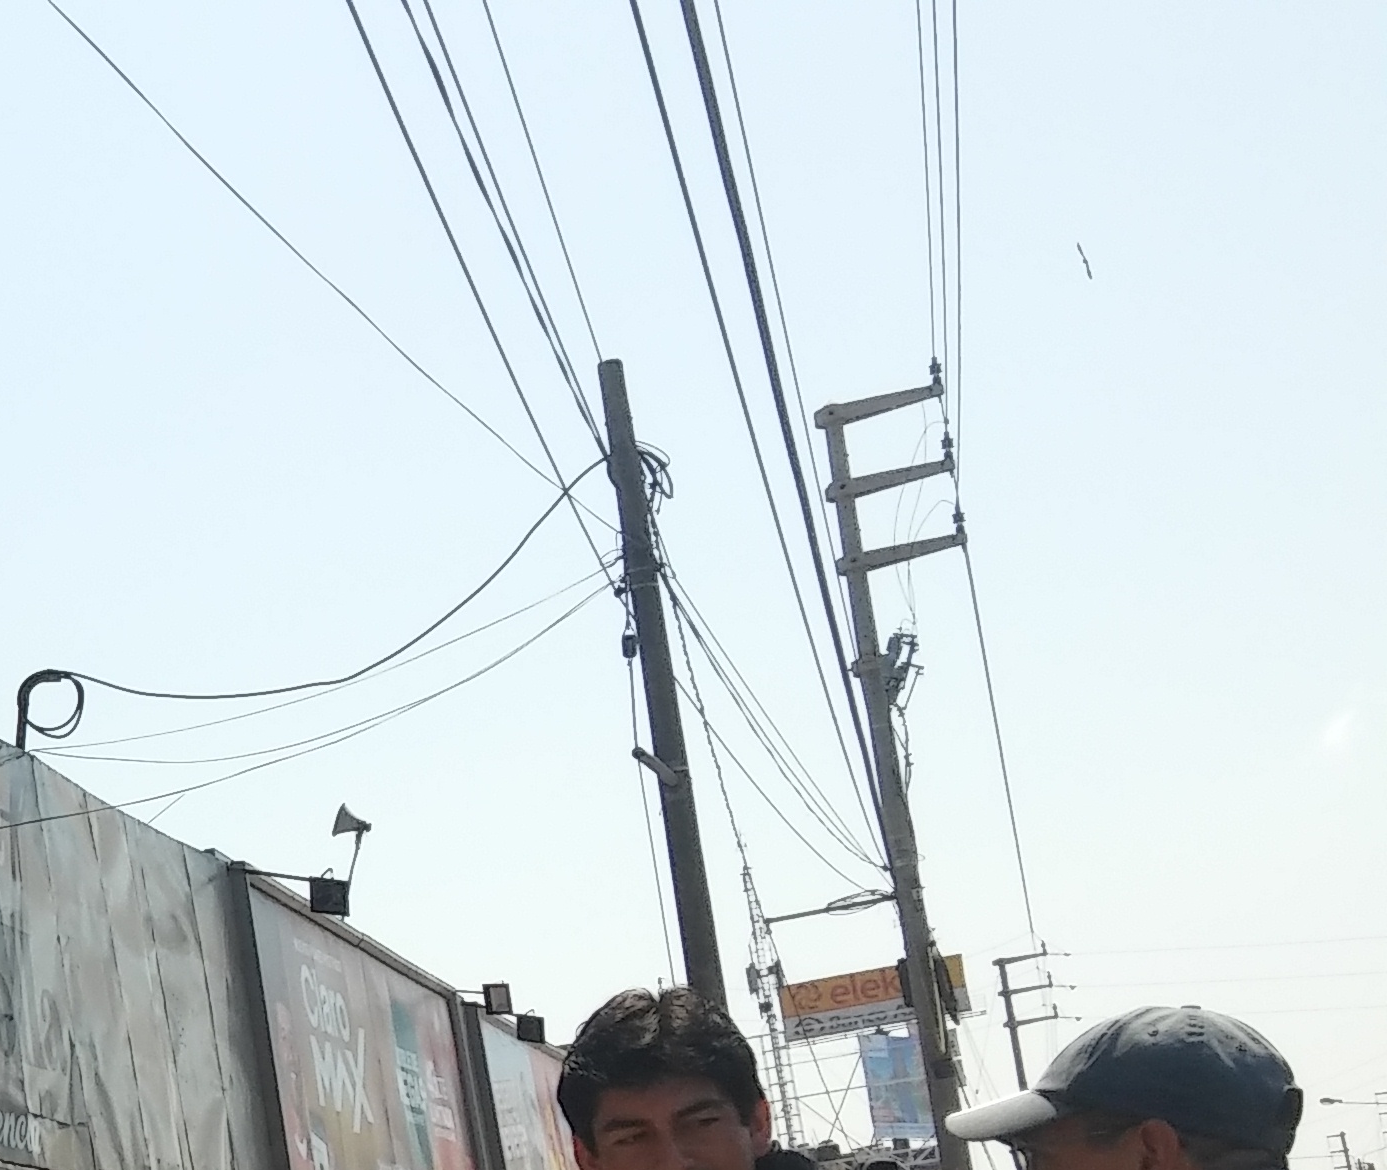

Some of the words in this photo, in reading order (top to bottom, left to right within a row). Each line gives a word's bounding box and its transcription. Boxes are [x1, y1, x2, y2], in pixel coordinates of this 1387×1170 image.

[300, 964, 351, 1043] Claro
[830, 971, 901, 1004] elek
[310, 1027, 375, 1135] MAX
